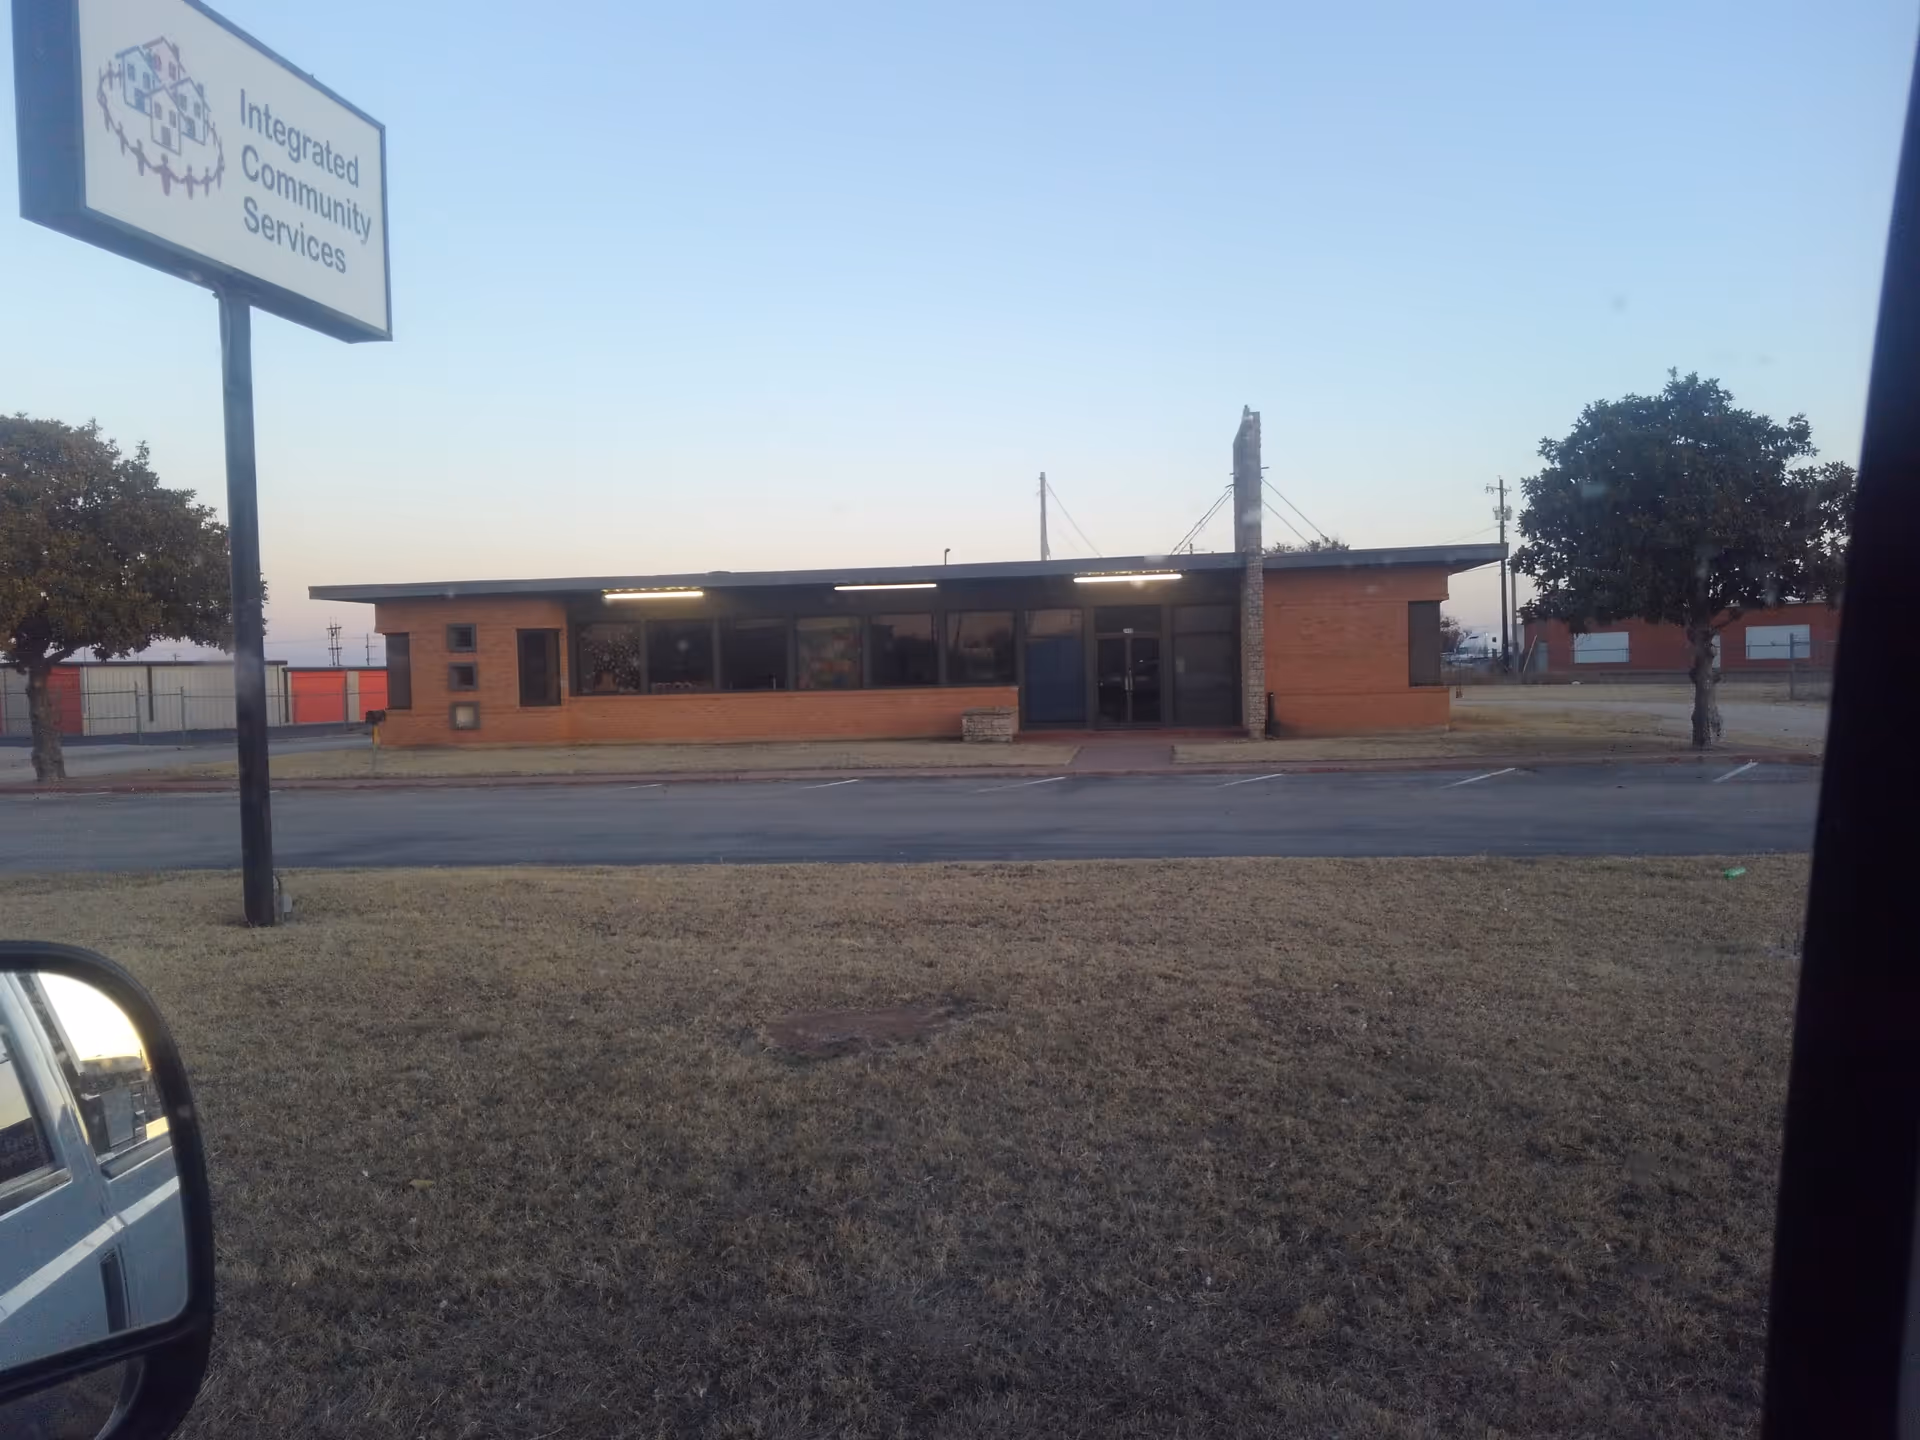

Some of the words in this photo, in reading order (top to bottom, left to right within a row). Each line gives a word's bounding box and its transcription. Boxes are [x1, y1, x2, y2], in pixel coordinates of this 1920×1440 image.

[240, 88, 359, 188] Integrated
[241, 145, 372, 245] Community
[243, 196, 346, 274] Services
